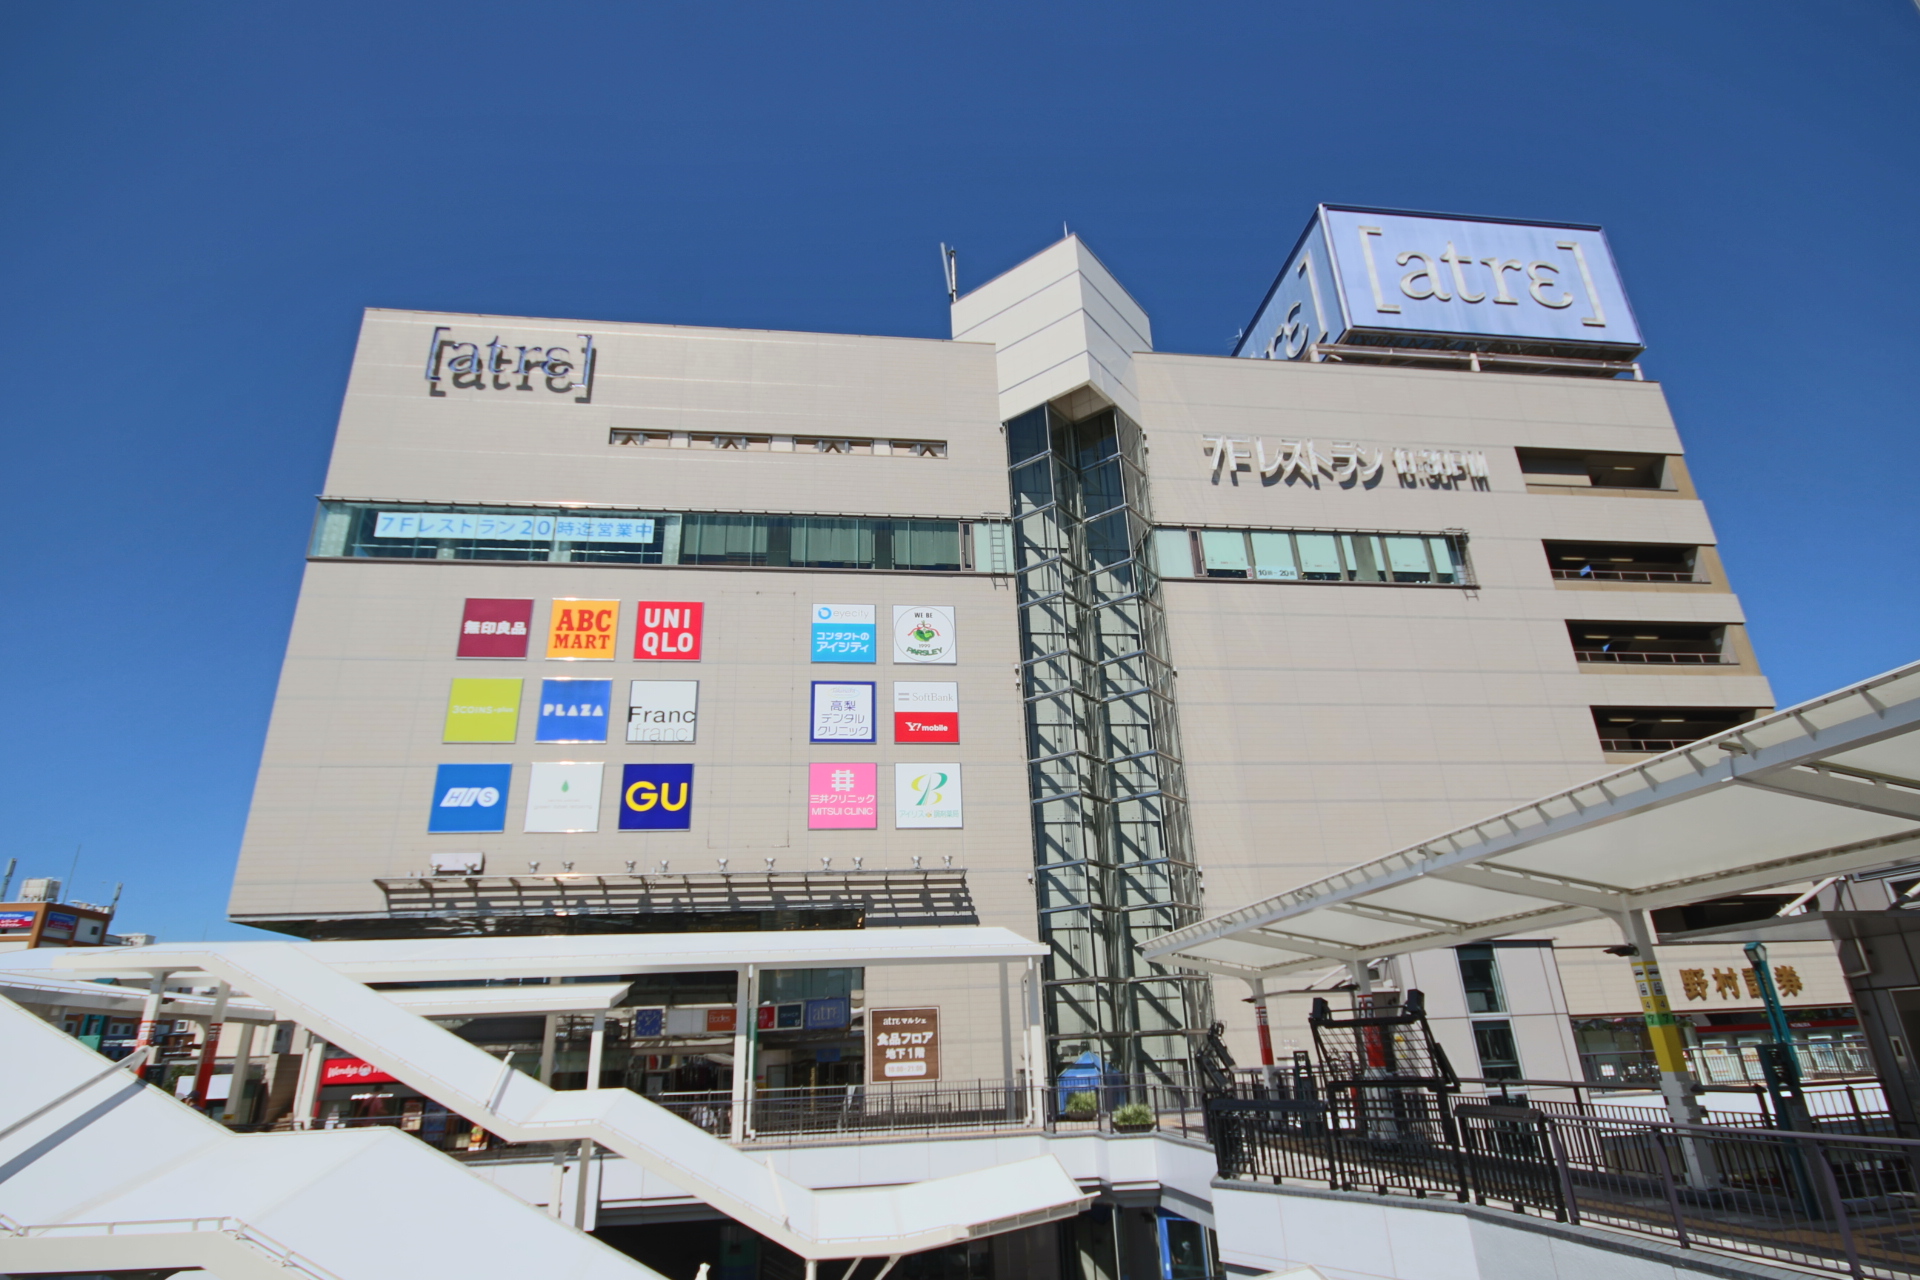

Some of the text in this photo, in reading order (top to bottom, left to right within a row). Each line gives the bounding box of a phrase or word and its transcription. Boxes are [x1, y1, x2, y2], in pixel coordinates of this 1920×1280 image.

[379, 516, 653, 538] 7Fレストラン20時迄営業中
[556, 609, 612, 632] ABC
[643, 608, 691, 629] UNI
[833, 609, 869, 619] eyecity
[464, 620, 526, 636] 無印良品
[553, 634, 610, 649] MART
[816, 631, 869, 641] コンタクトの
[642, 632, 694, 656] QLO
[816, 642, 869, 653] アイシティ
[906, 647, 943, 656] PARSLEY
[912, 692, 954, 702] SoftBank
[542, 704, 604, 717] PLAZA
[831, 700, 856, 711] 高梨
[628, 706, 696, 724] Franc
[821, 713, 865, 724] デンタル
[634, 723, 688, 742] franc
[817, 726, 869, 736] クリニック
[625, 781, 688, 812] GU
[810, 794, 875, 804] 三井クリニック
[811, 807, 874, 816] MITSUI CLINIC
[876, 1031, 934, 1046] 食品フロア
[885, 1047, 926, 1060] 地下1階
